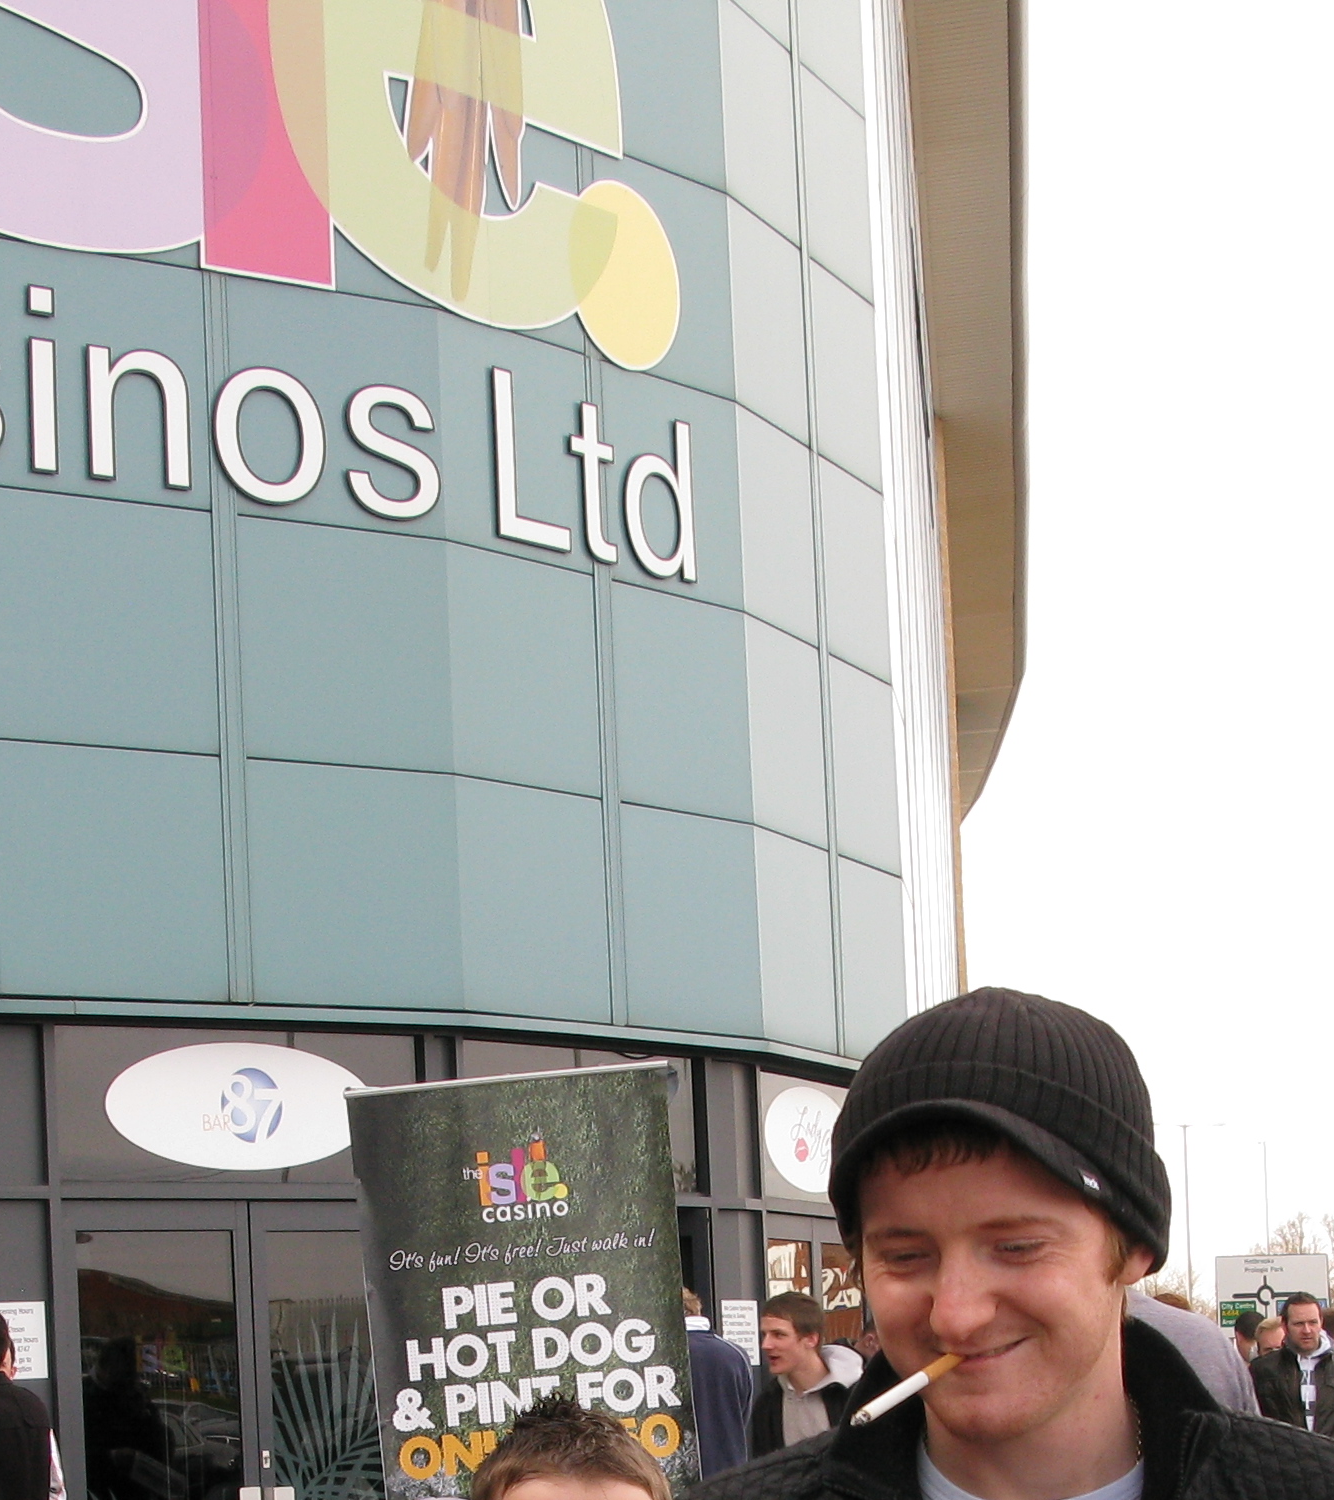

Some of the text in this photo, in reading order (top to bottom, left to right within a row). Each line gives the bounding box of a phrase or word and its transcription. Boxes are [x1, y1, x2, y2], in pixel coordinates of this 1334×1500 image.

[490, 366, 698, 583] Ltd
[202, 1074, 284, 1143] BAR 87
[462, 1166, 483, 1180] the
[475, 1147, 568, 1206] isle
[482, 1197, 569, 1223] casino
[389, 1228, 656, 1273] It's fun! It's free! Just walk in!
[441, 1273, 612, 1330] PIE OR
[405, 1318, 657, 1382] HOT DOG
[392, 1387, 436, 1433] &
[576, 1365, 682, 1412] FOR
